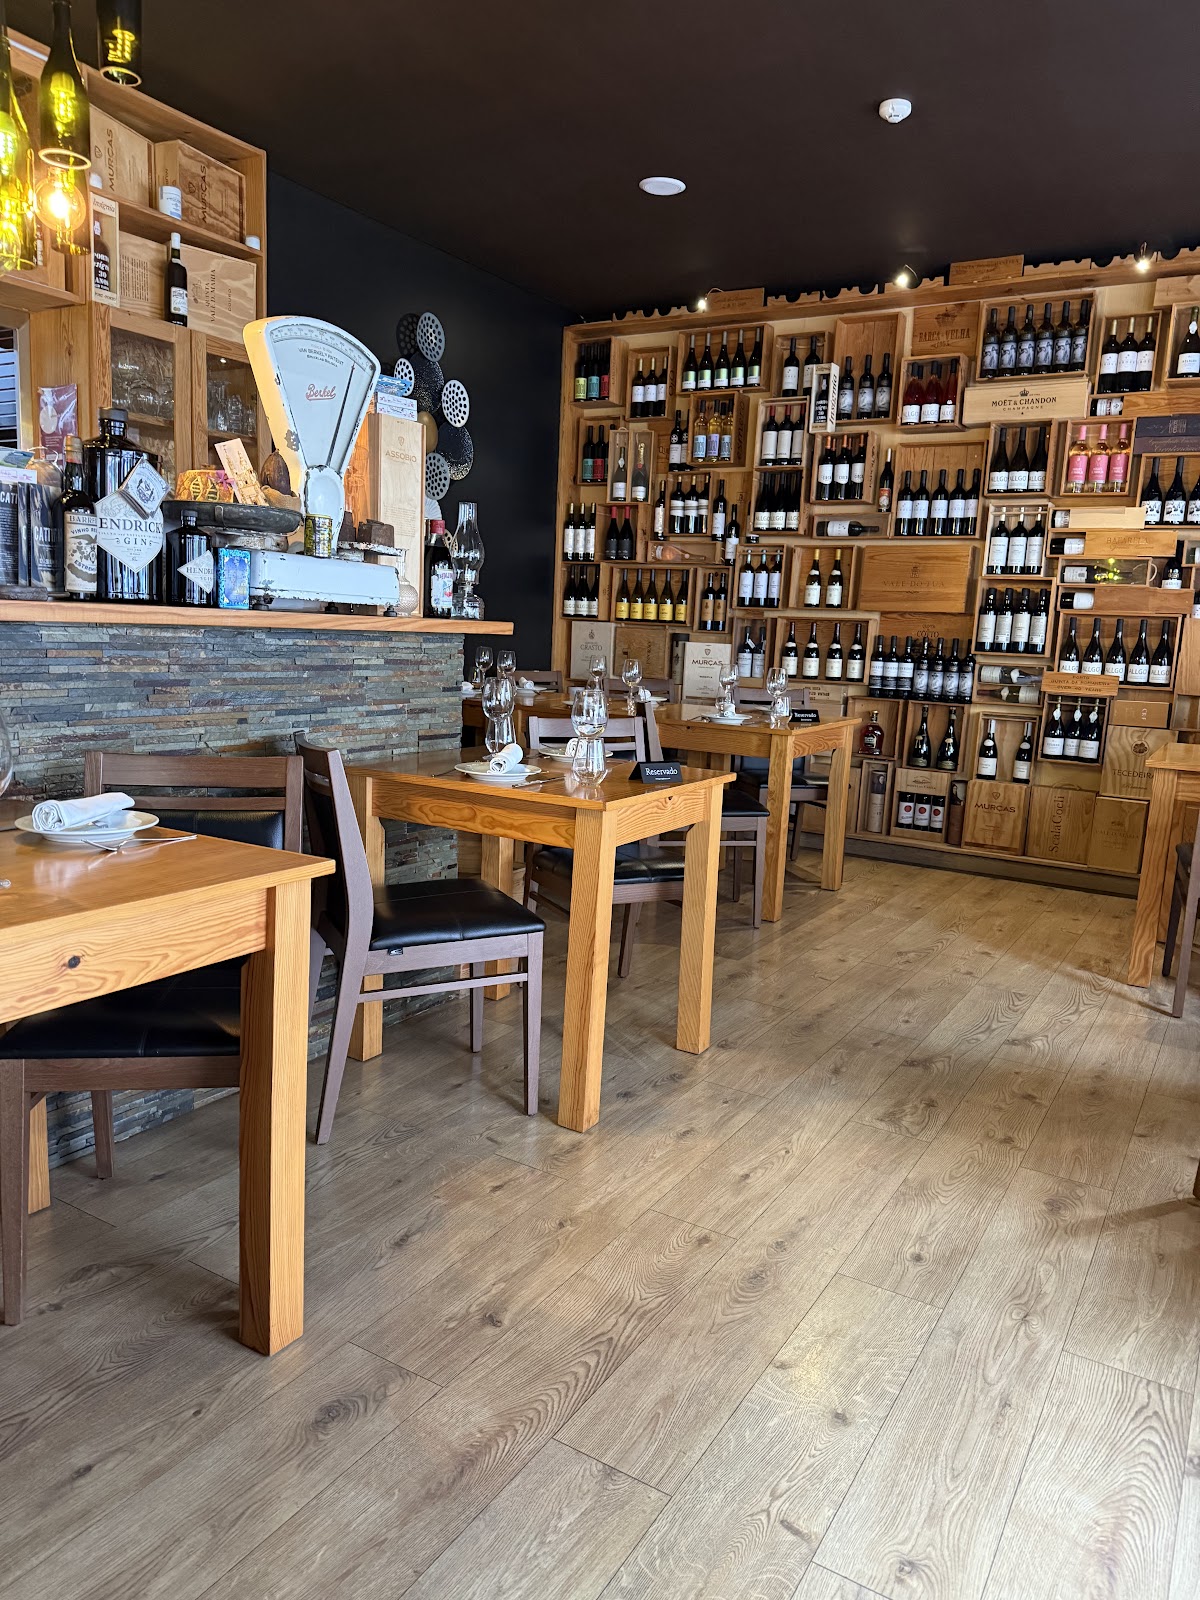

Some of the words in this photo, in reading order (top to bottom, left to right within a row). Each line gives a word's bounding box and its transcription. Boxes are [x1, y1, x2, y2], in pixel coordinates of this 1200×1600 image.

[306, 384, 336, 401] Berkel
[1019, 396, 1057, 406] CHANDON
[385, 450, 417, 463] ASSOBIO
[99, 517, 163, 534] ENDRICK
[124, 537, 147, 546] GIN
[645, 766, 678, 776] Reservado
